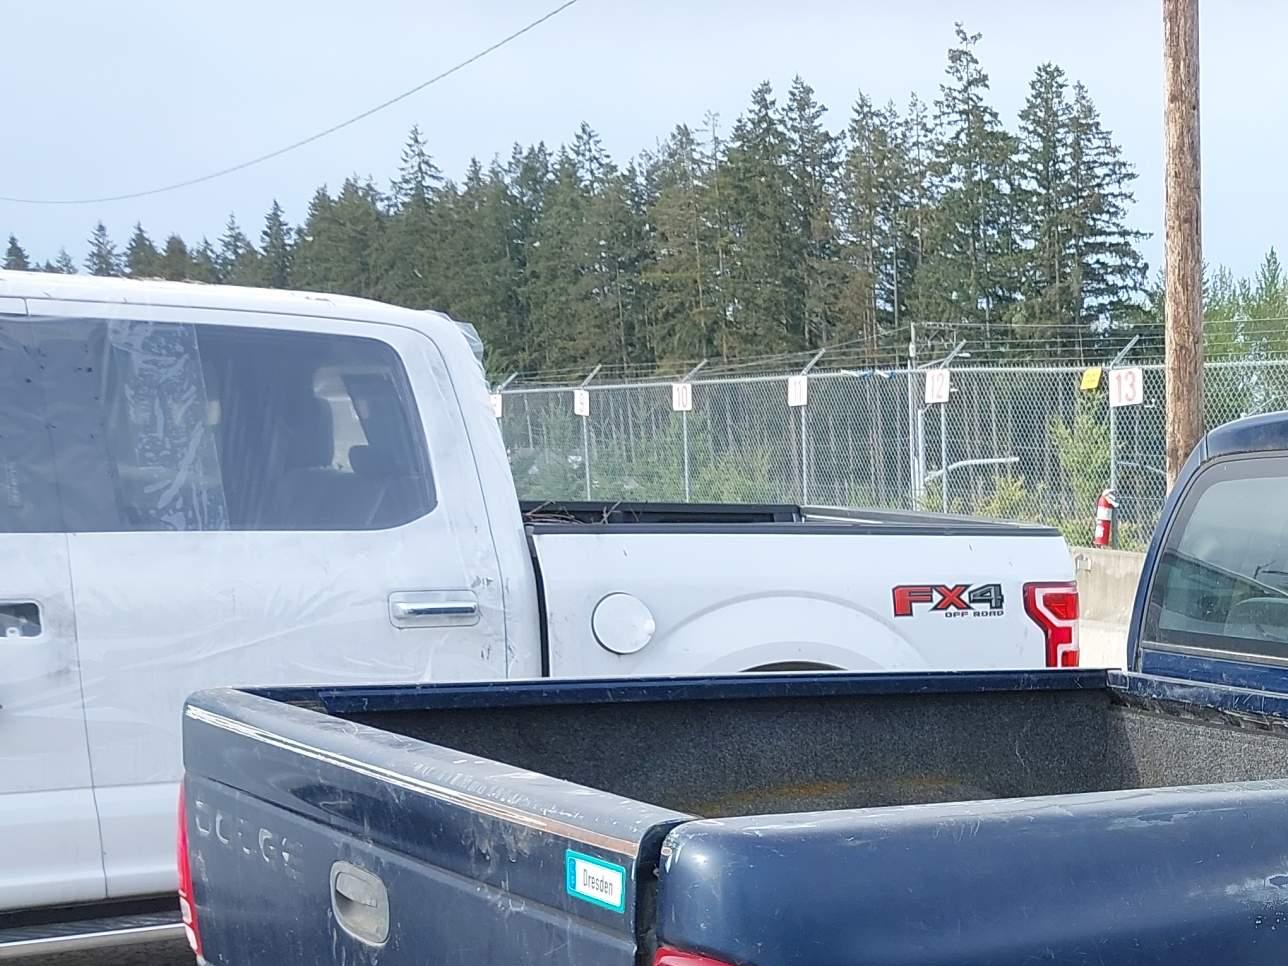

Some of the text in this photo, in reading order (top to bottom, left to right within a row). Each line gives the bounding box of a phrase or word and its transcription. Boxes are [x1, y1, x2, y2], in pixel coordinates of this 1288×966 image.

[675, 385, 688, 408] 10
[931, 373, 945, 399] 12
[1116, 371, 1136, 402] 13
[892, 584, 1004, 617] FX4
[583, 868, 613, 896] Dresden
